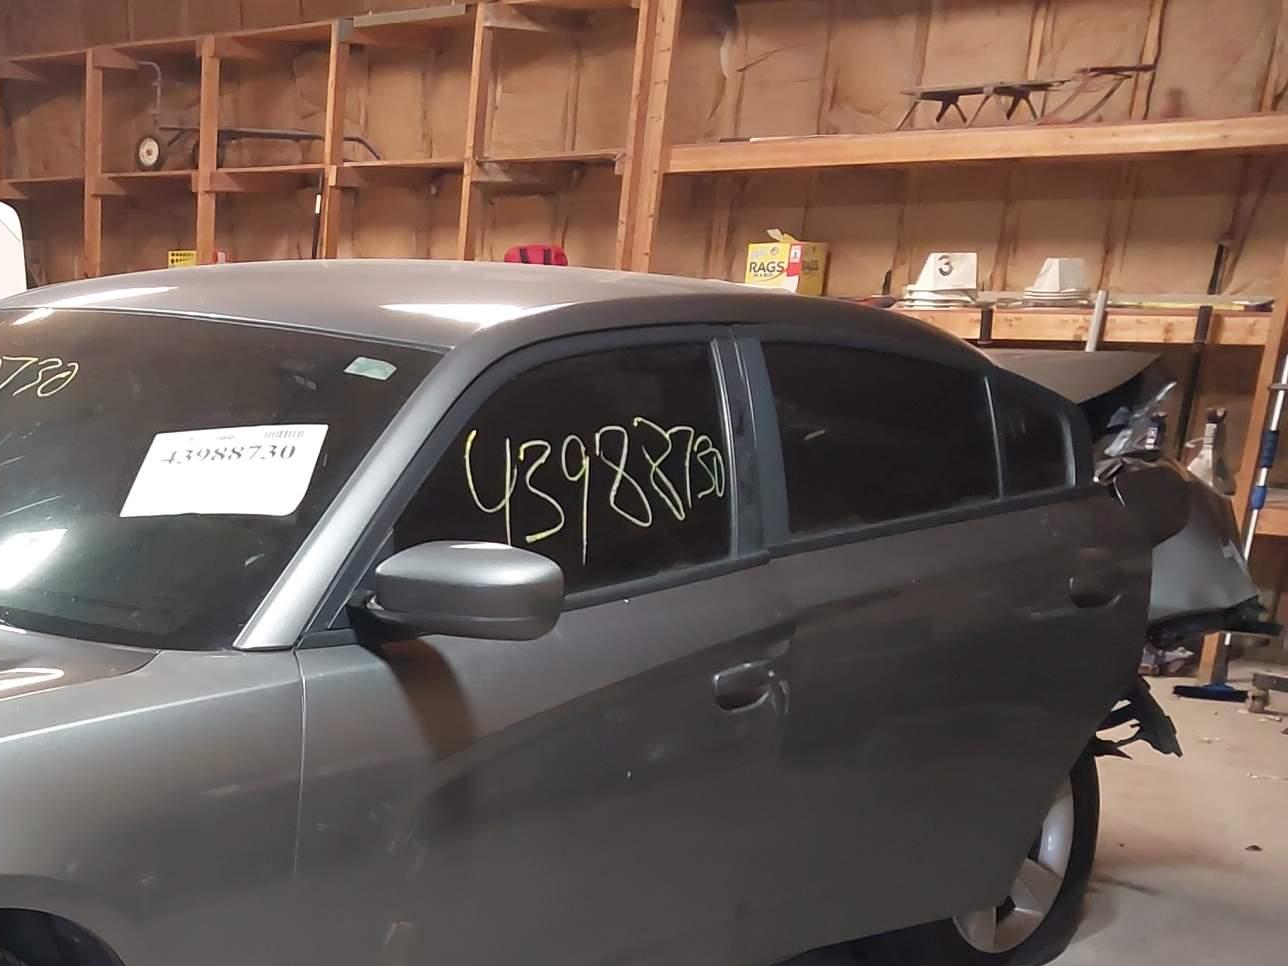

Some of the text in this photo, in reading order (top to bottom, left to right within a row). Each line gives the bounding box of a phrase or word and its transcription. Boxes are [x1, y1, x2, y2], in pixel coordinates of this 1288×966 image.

[749, 261, 785, 273] RAGS
[938, 255, 954, 276] 3
[160, 444, 296, 465] 43988730
[464, 417, 726, 566] 43988730
